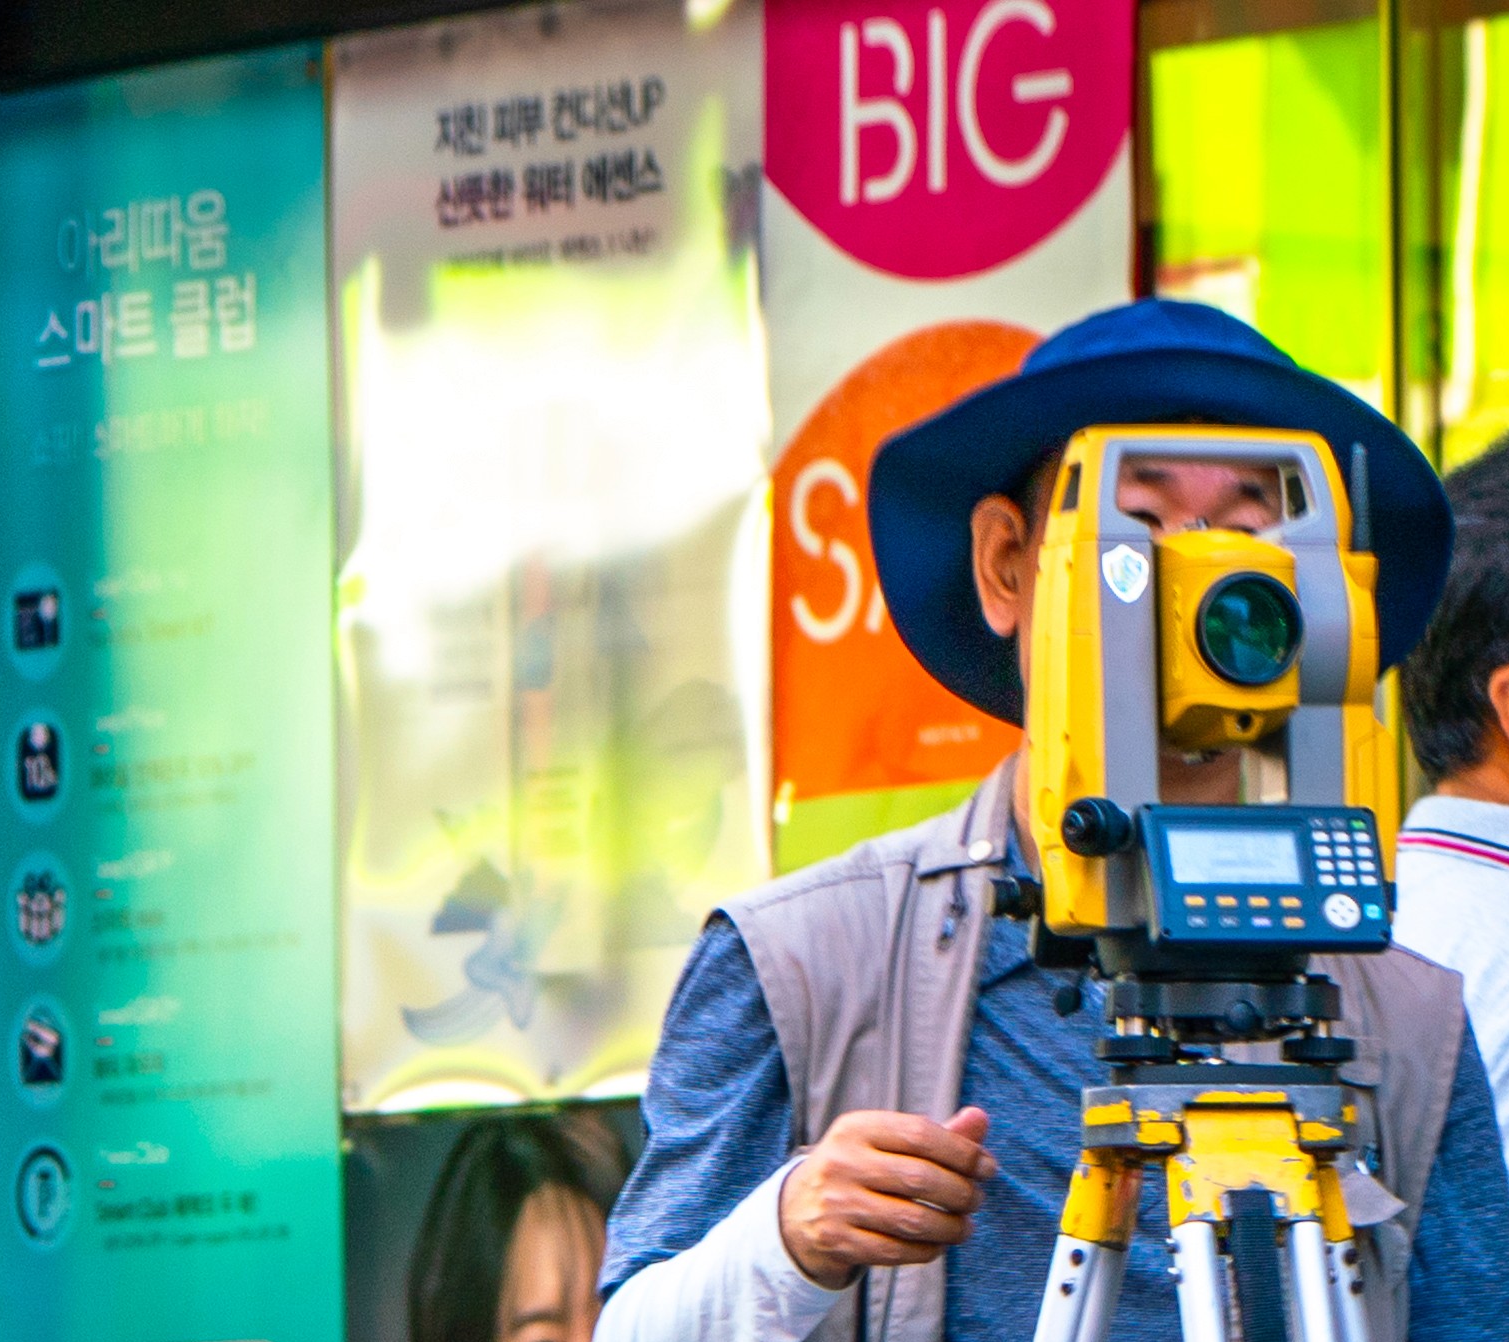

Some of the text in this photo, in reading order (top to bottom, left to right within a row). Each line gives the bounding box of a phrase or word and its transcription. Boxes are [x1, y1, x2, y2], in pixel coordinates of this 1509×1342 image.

[838, 0, 1074, 207] BIG
[56, 188, 230, 275] 아리따움
[36, 270, 258, 368] 스마트 클럽
